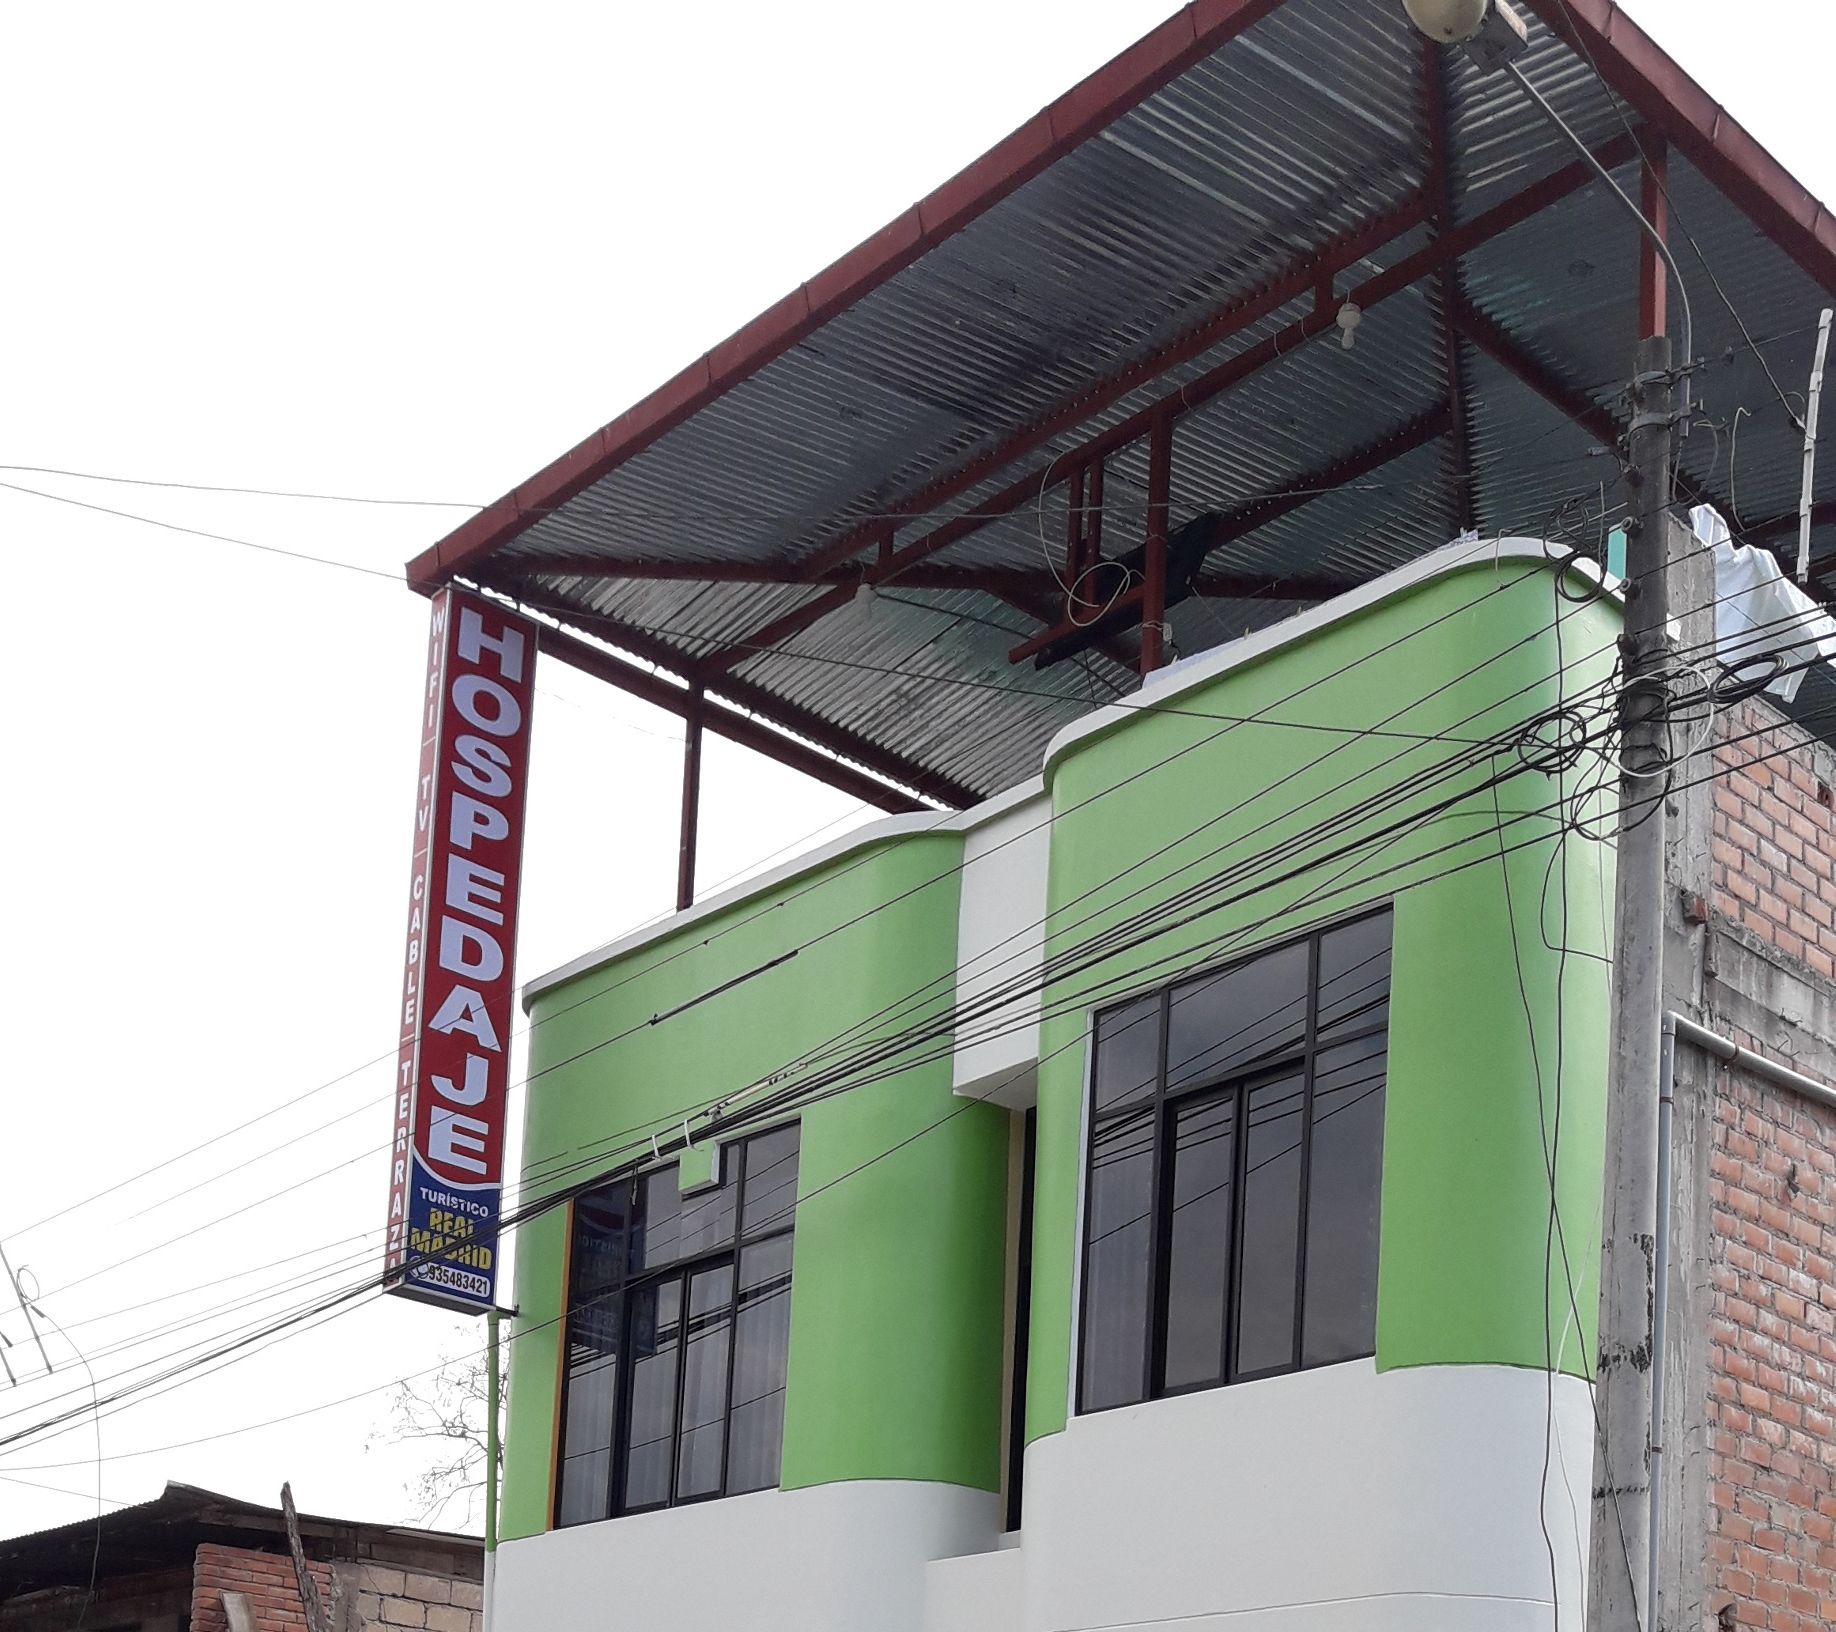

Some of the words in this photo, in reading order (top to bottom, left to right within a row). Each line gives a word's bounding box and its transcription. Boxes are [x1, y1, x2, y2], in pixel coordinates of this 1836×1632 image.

[428, 607, 445, 728] WIFI
[419, 774, 431, 832] TV
[428, 606, 525, 1175] HOSPEDAJE
[404, 875, 423, 1025] CABLE
[420, 1187, 488, 1217] TURÍSTICO
[429, 1264, 488, 1296] 935483421
